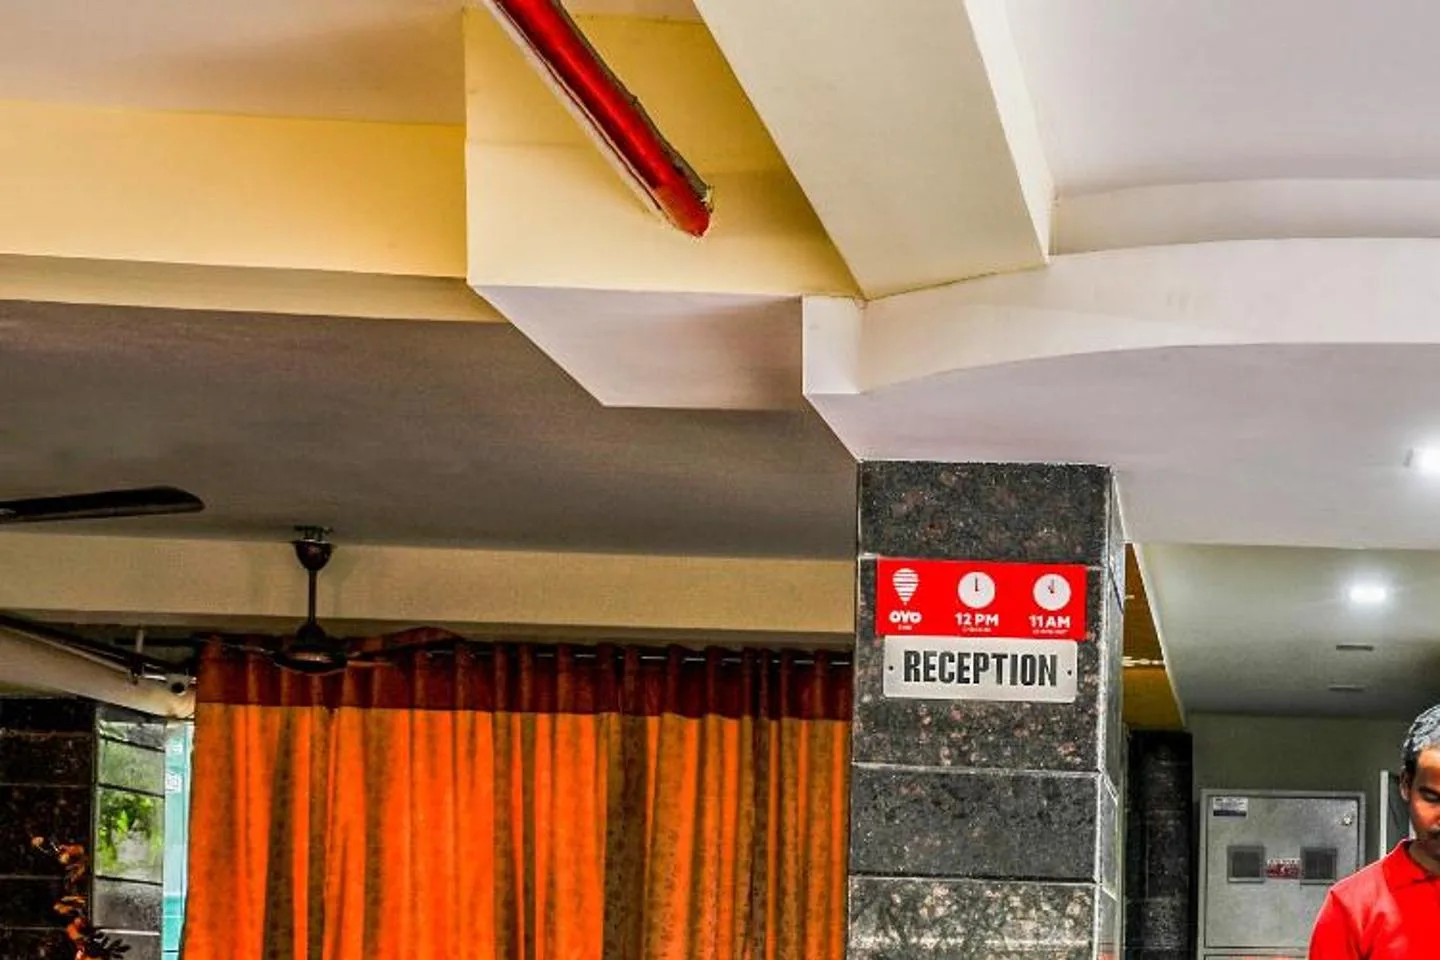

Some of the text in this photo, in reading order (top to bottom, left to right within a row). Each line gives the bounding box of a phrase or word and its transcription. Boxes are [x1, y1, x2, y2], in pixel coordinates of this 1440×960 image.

[889, 610, 922, 624] OYO
[955, 612, 999, 627] 12 PM
[1028, 615, 1071, 629] 11 AM
[903, 650, 1057, 686] RECEPTION
